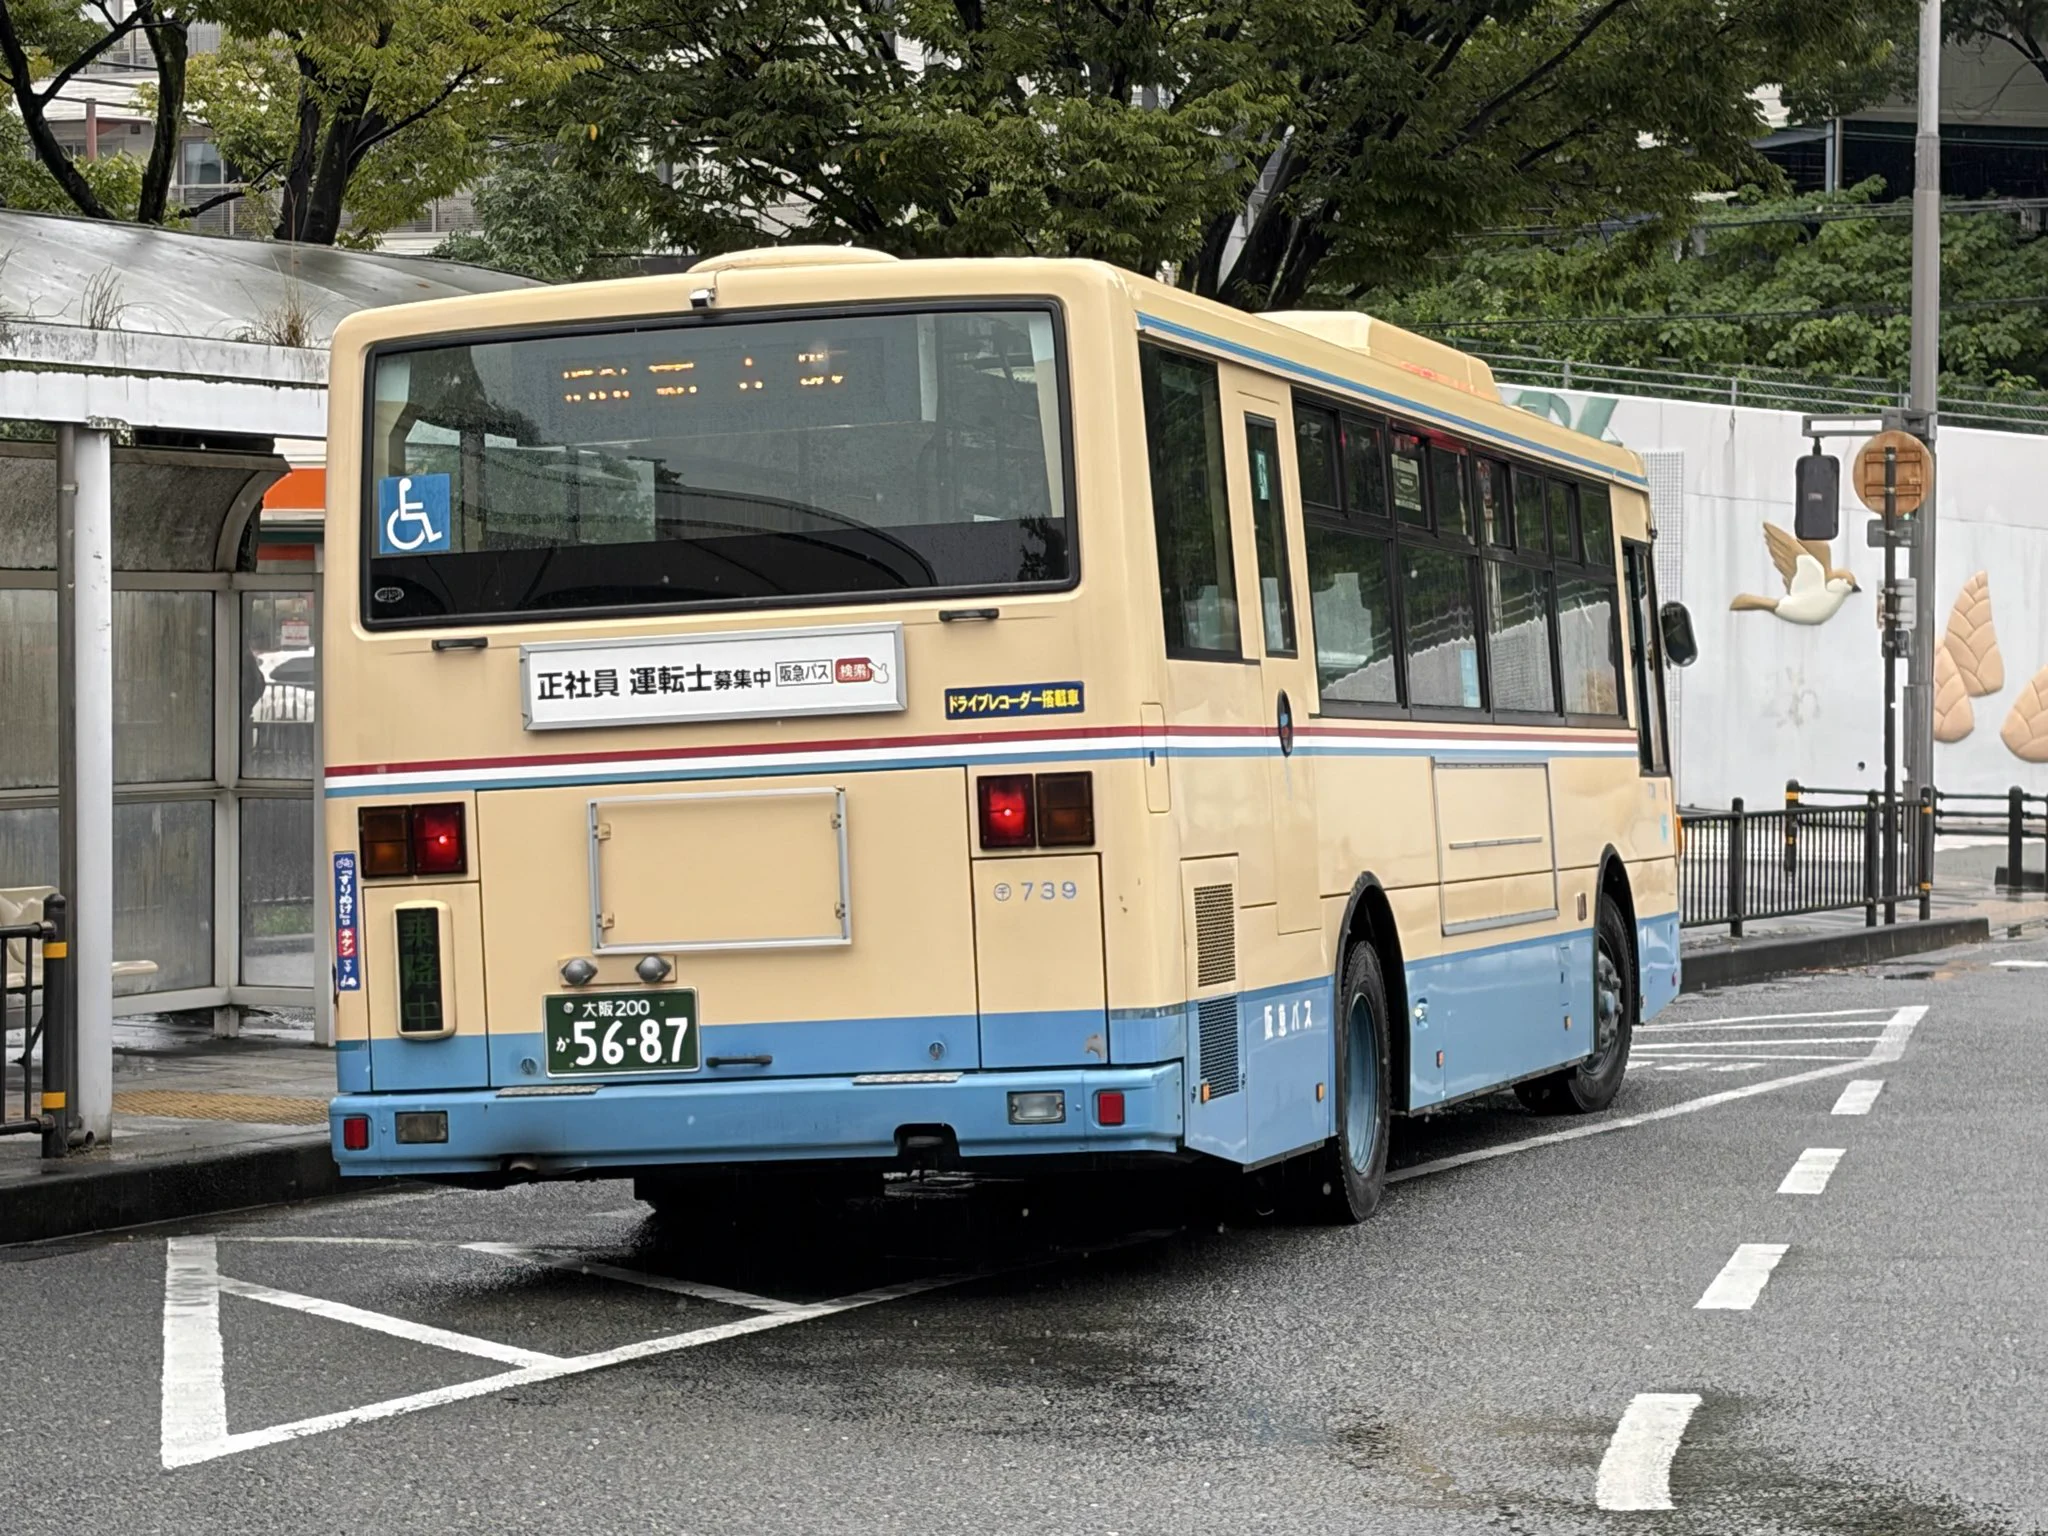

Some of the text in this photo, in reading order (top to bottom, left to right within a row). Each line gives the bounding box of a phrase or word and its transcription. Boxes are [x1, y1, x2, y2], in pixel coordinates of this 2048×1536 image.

[537, 669, 620, 701] 正社員
[630, 664, 771, 696] 運転士募集中
[779, 664, 829, 683] 阪急バス
[1021, 881, 1077, 901] 739
[582, 1000, 650, 1018] 大阪200
[573, 1017, 688, 1066] 56-87
